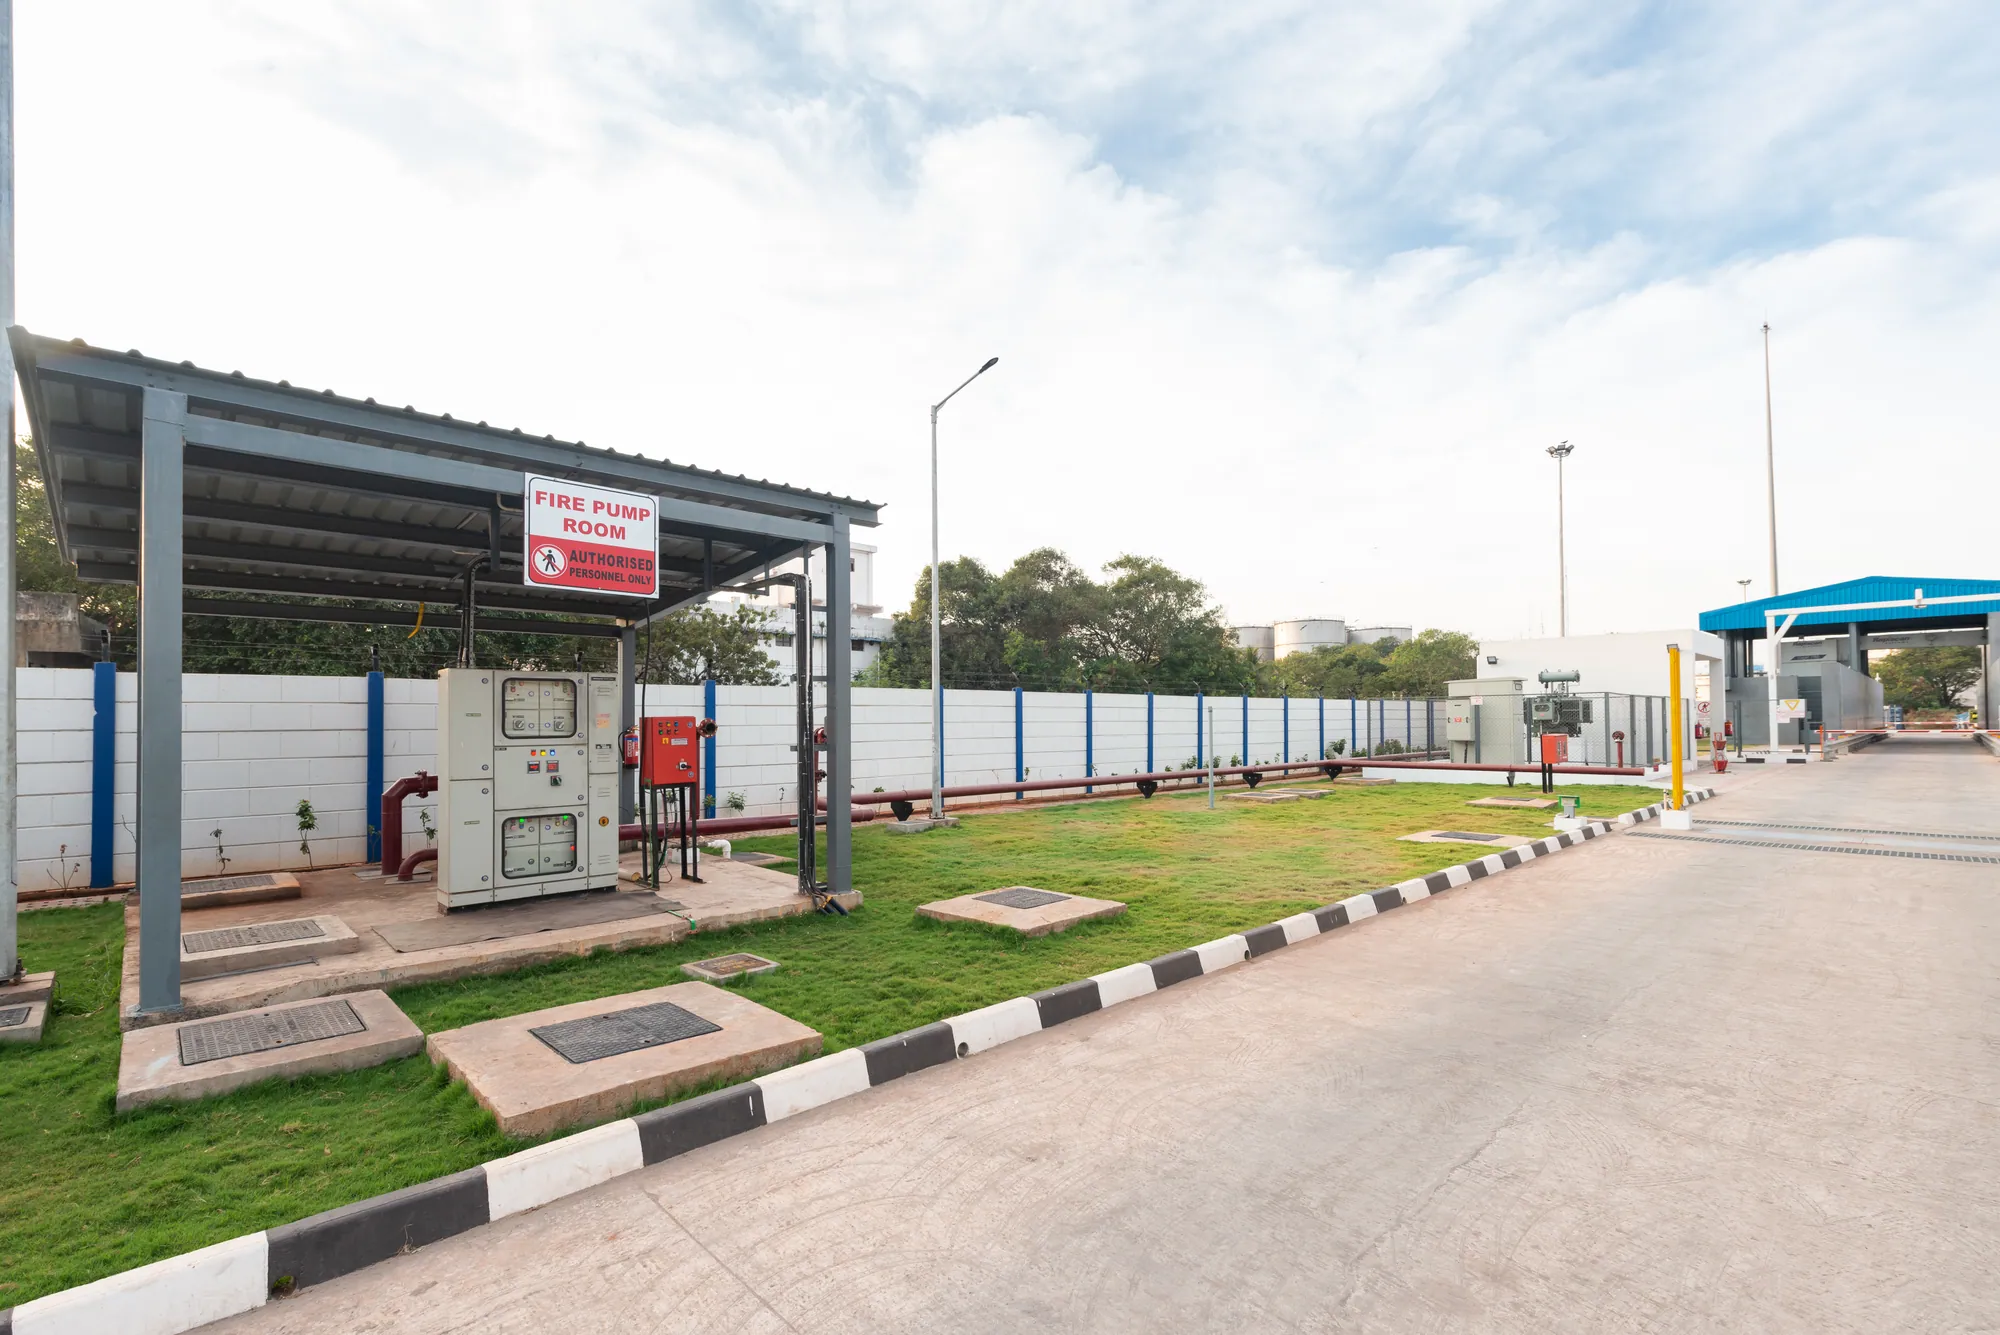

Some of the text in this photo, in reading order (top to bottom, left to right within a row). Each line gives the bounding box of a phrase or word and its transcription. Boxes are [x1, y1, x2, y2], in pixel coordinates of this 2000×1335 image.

[535, 490, 651, 521] FIRE PUMP
[563, 517, 626, 540] ROOM
[569, 549, 653, 571] AUTHORISED
[569, 567, 652, 585] PERSONNEL ONLY
